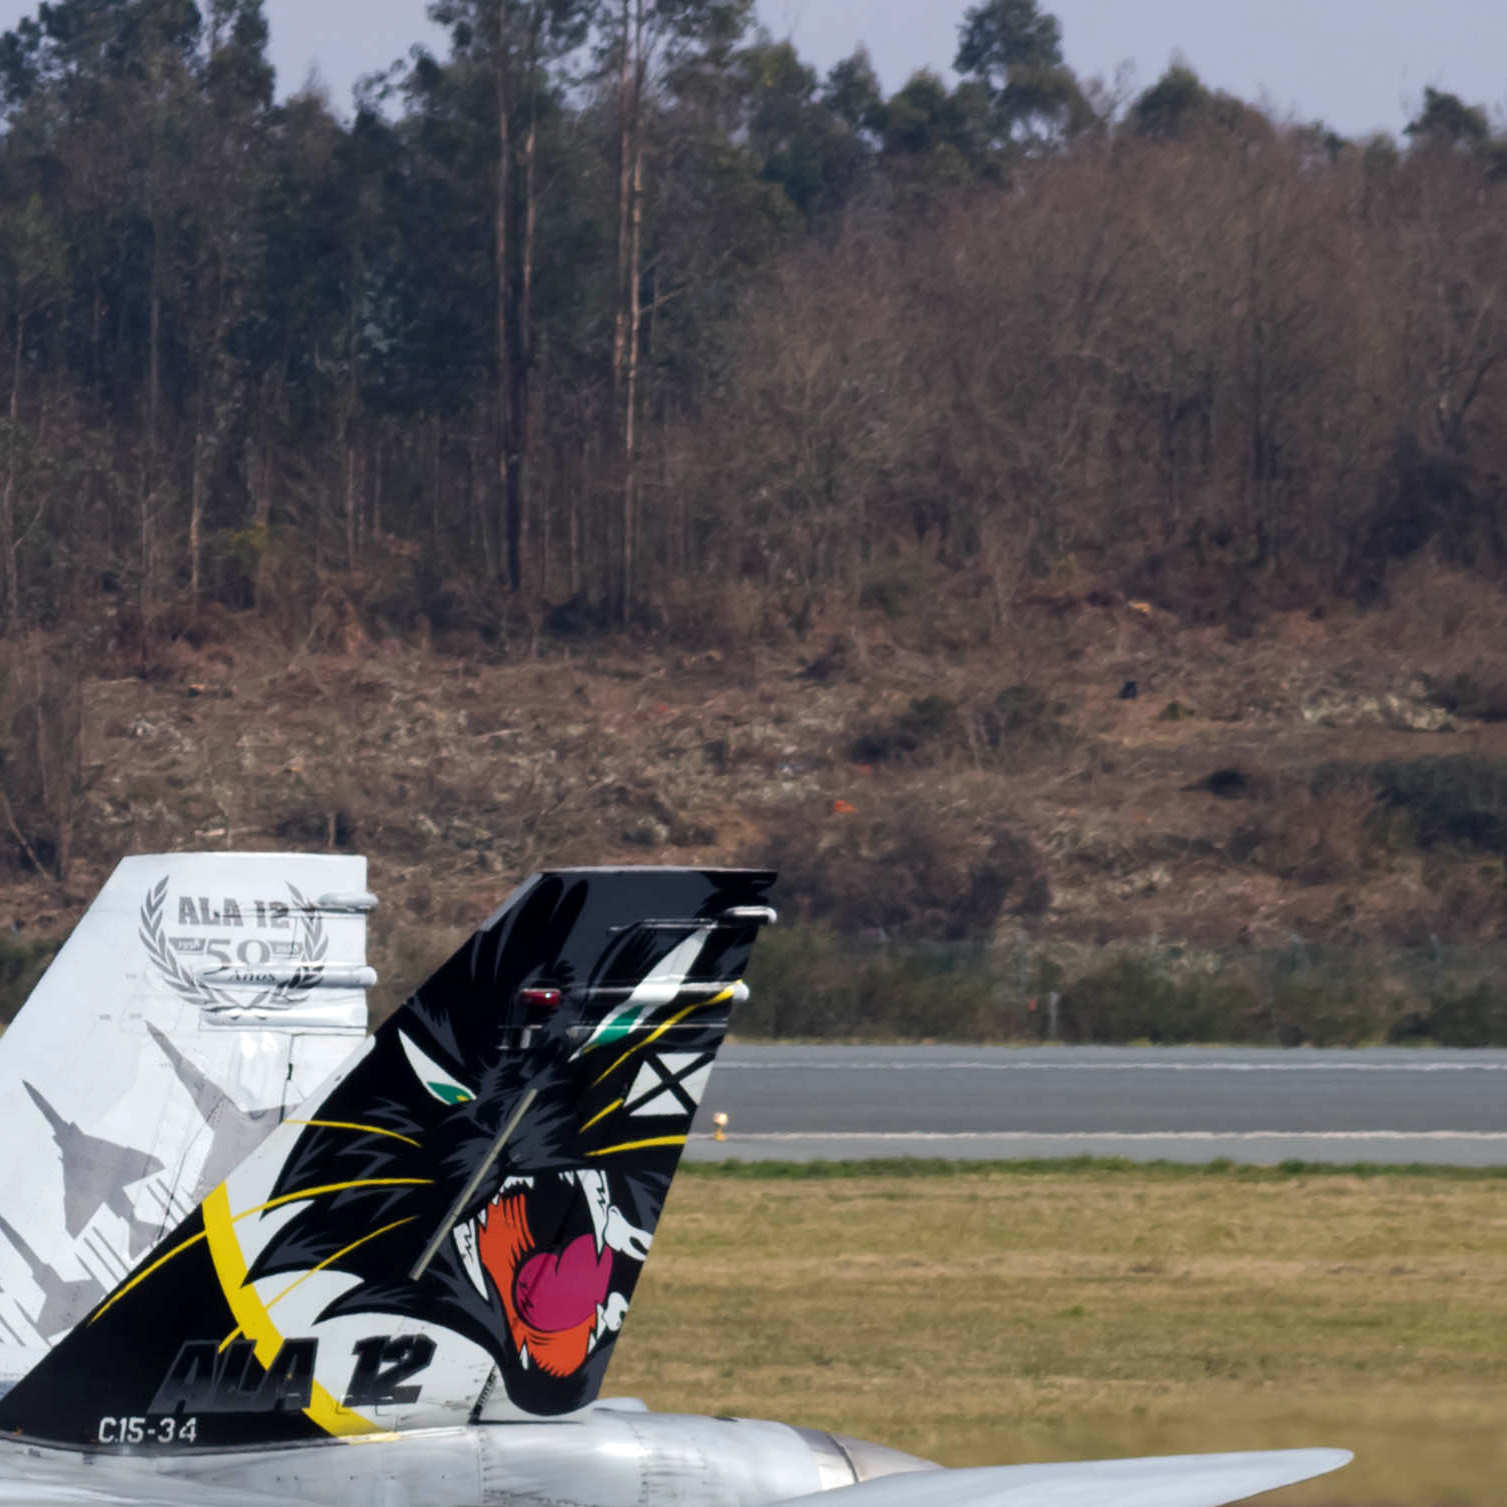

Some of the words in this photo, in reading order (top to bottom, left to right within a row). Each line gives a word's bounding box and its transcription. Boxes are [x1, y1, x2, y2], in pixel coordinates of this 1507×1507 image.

[177, 896, 244, 927] ALA
[253, 899, 291, 929] 12
[203, 939, 271, 975] 50
[146, 1337, 319, 1414] ALA
[340, 1333, 438, 1407] 12
